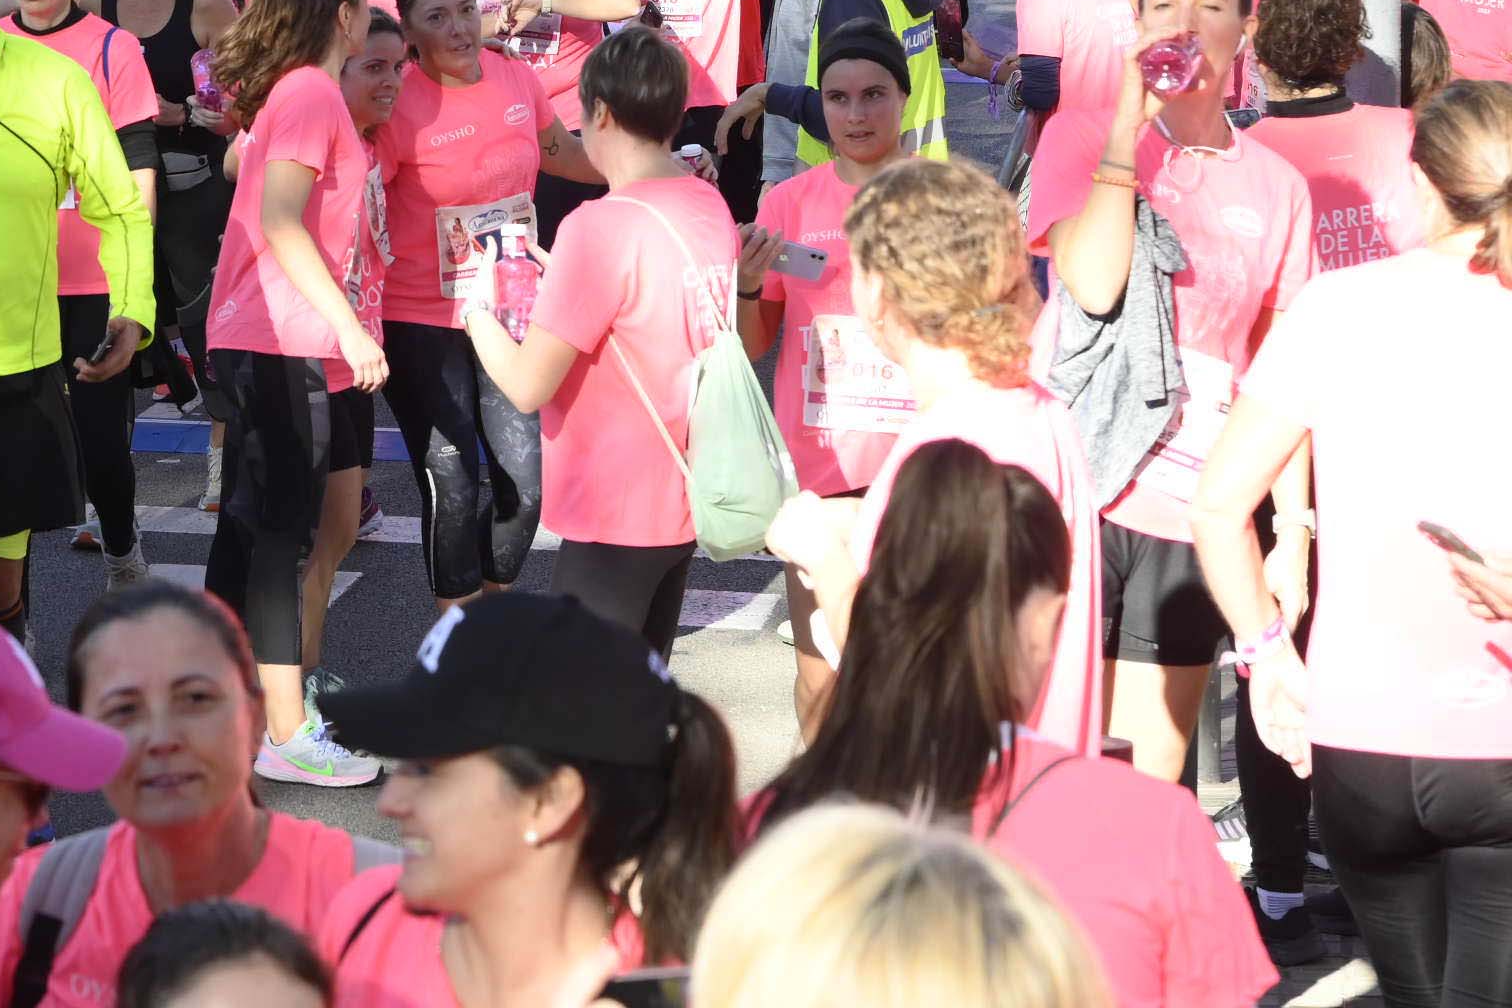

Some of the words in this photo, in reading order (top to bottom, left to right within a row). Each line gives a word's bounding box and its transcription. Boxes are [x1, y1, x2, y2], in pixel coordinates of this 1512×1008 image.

[431, 124, 476, 147] OYSHO
[1317, 203, 1401, 230] ARRERA
[1320, 231, 1350, 255] DE
[1356, 226, 1385, 250] LA
